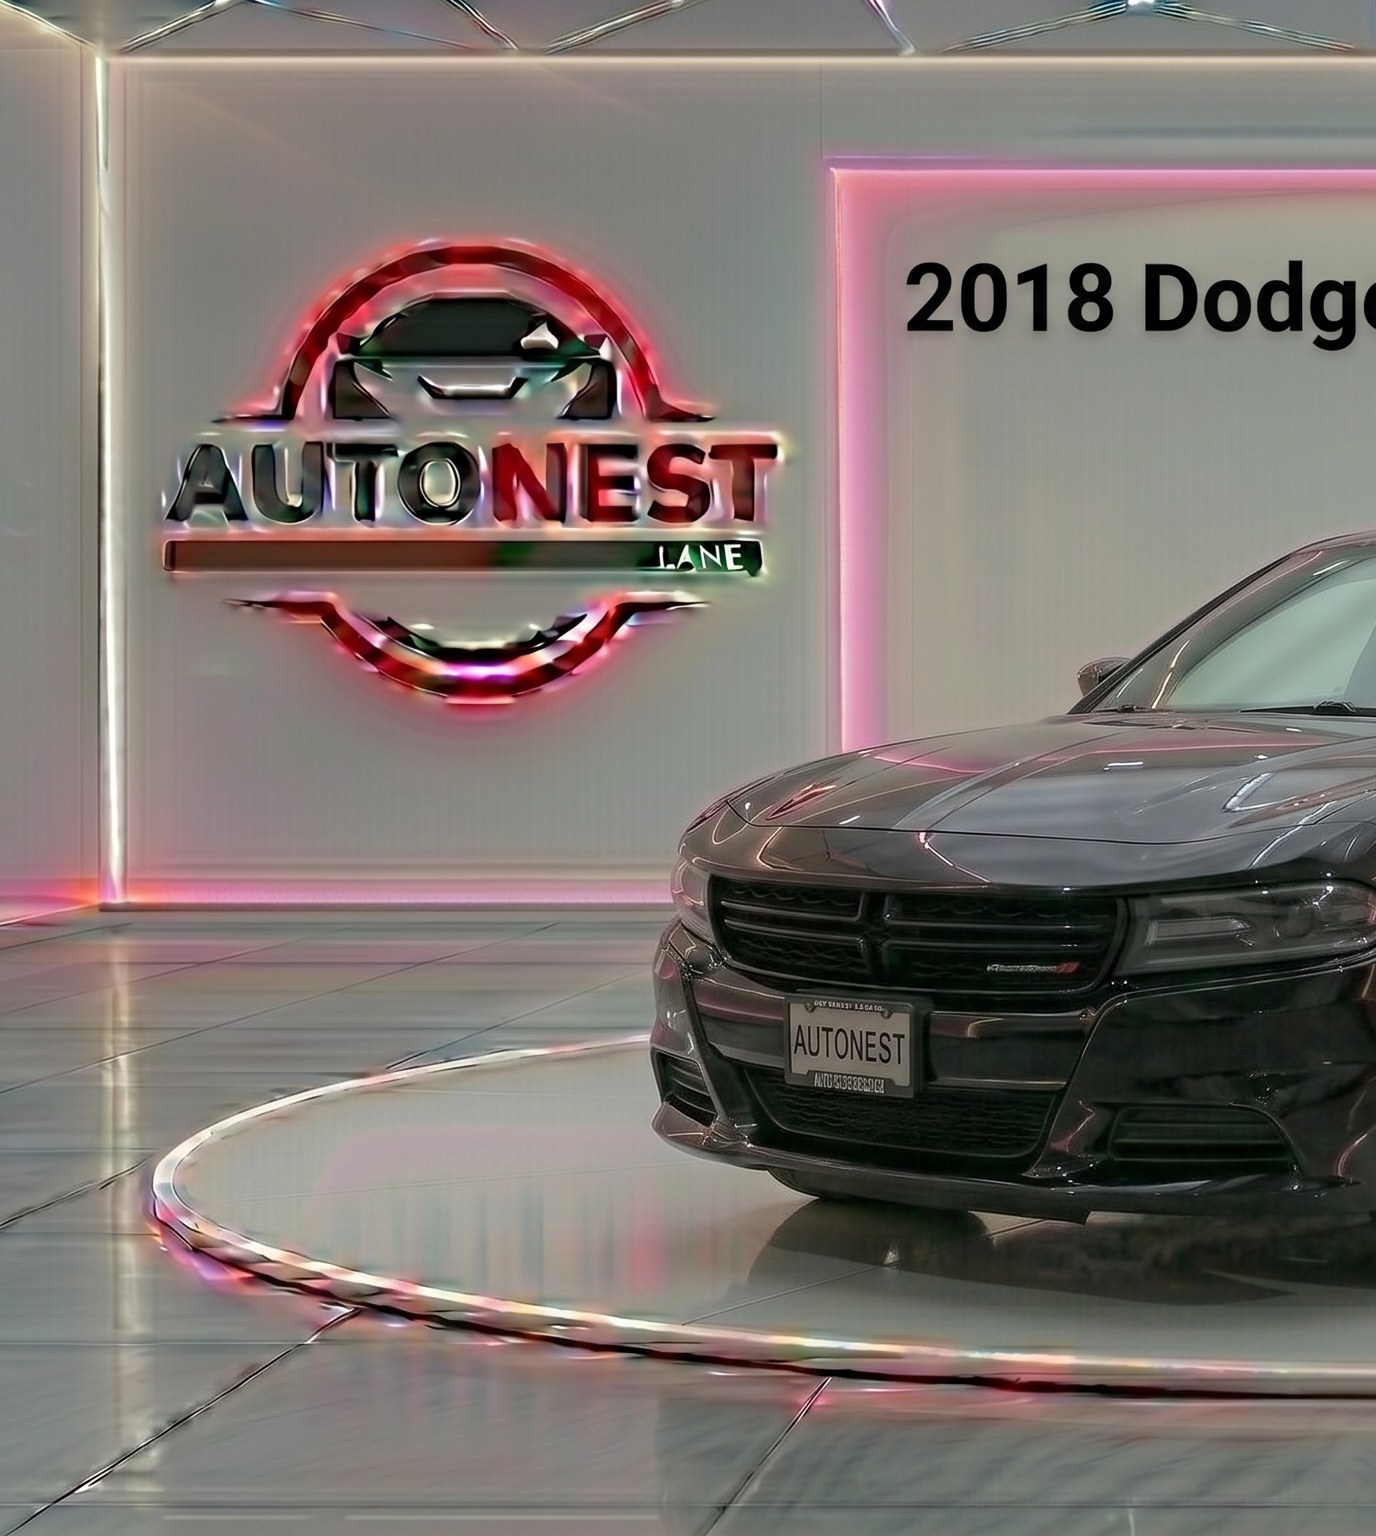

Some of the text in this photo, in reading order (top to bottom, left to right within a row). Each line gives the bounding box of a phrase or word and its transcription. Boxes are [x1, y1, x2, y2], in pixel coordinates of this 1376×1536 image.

[164, 440, 779, 525] AUTONEST
[658, 543, 744, 571] LANE
[793, 1024, 906, 1066] AUTONEST
